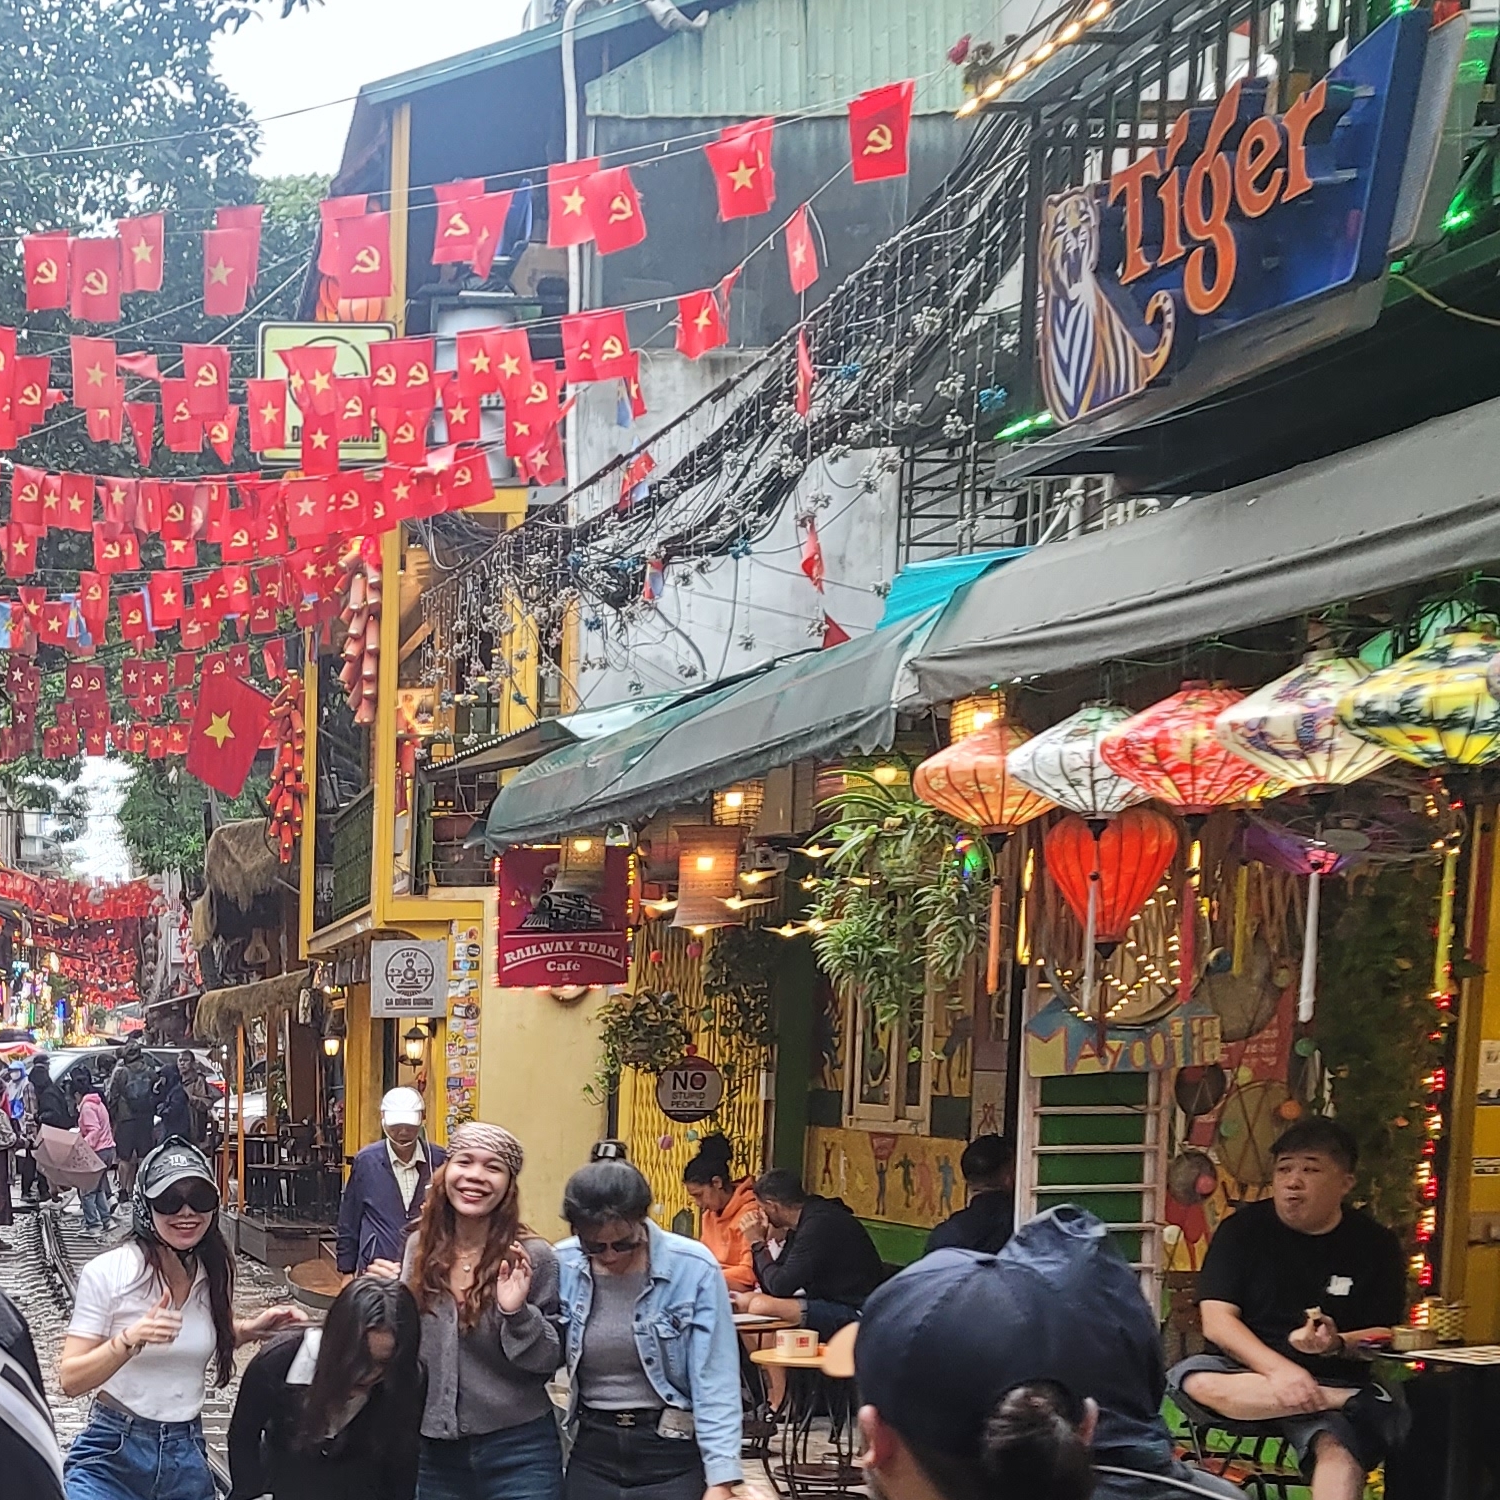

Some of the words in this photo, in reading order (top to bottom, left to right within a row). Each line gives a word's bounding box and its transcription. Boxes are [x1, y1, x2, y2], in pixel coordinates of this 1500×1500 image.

[1109, 79, 1328, 316] Tiger
[503, 940, 575, 964] RAILWAY
[578, 940, 619, 959] TUAN
[546, 960, 581, 972] Café
[672, 1071, 707, 1090] NO
[671, 1091, 706, 1100] STUPID
[671, 1100, 705, 1109] PEOPLE
